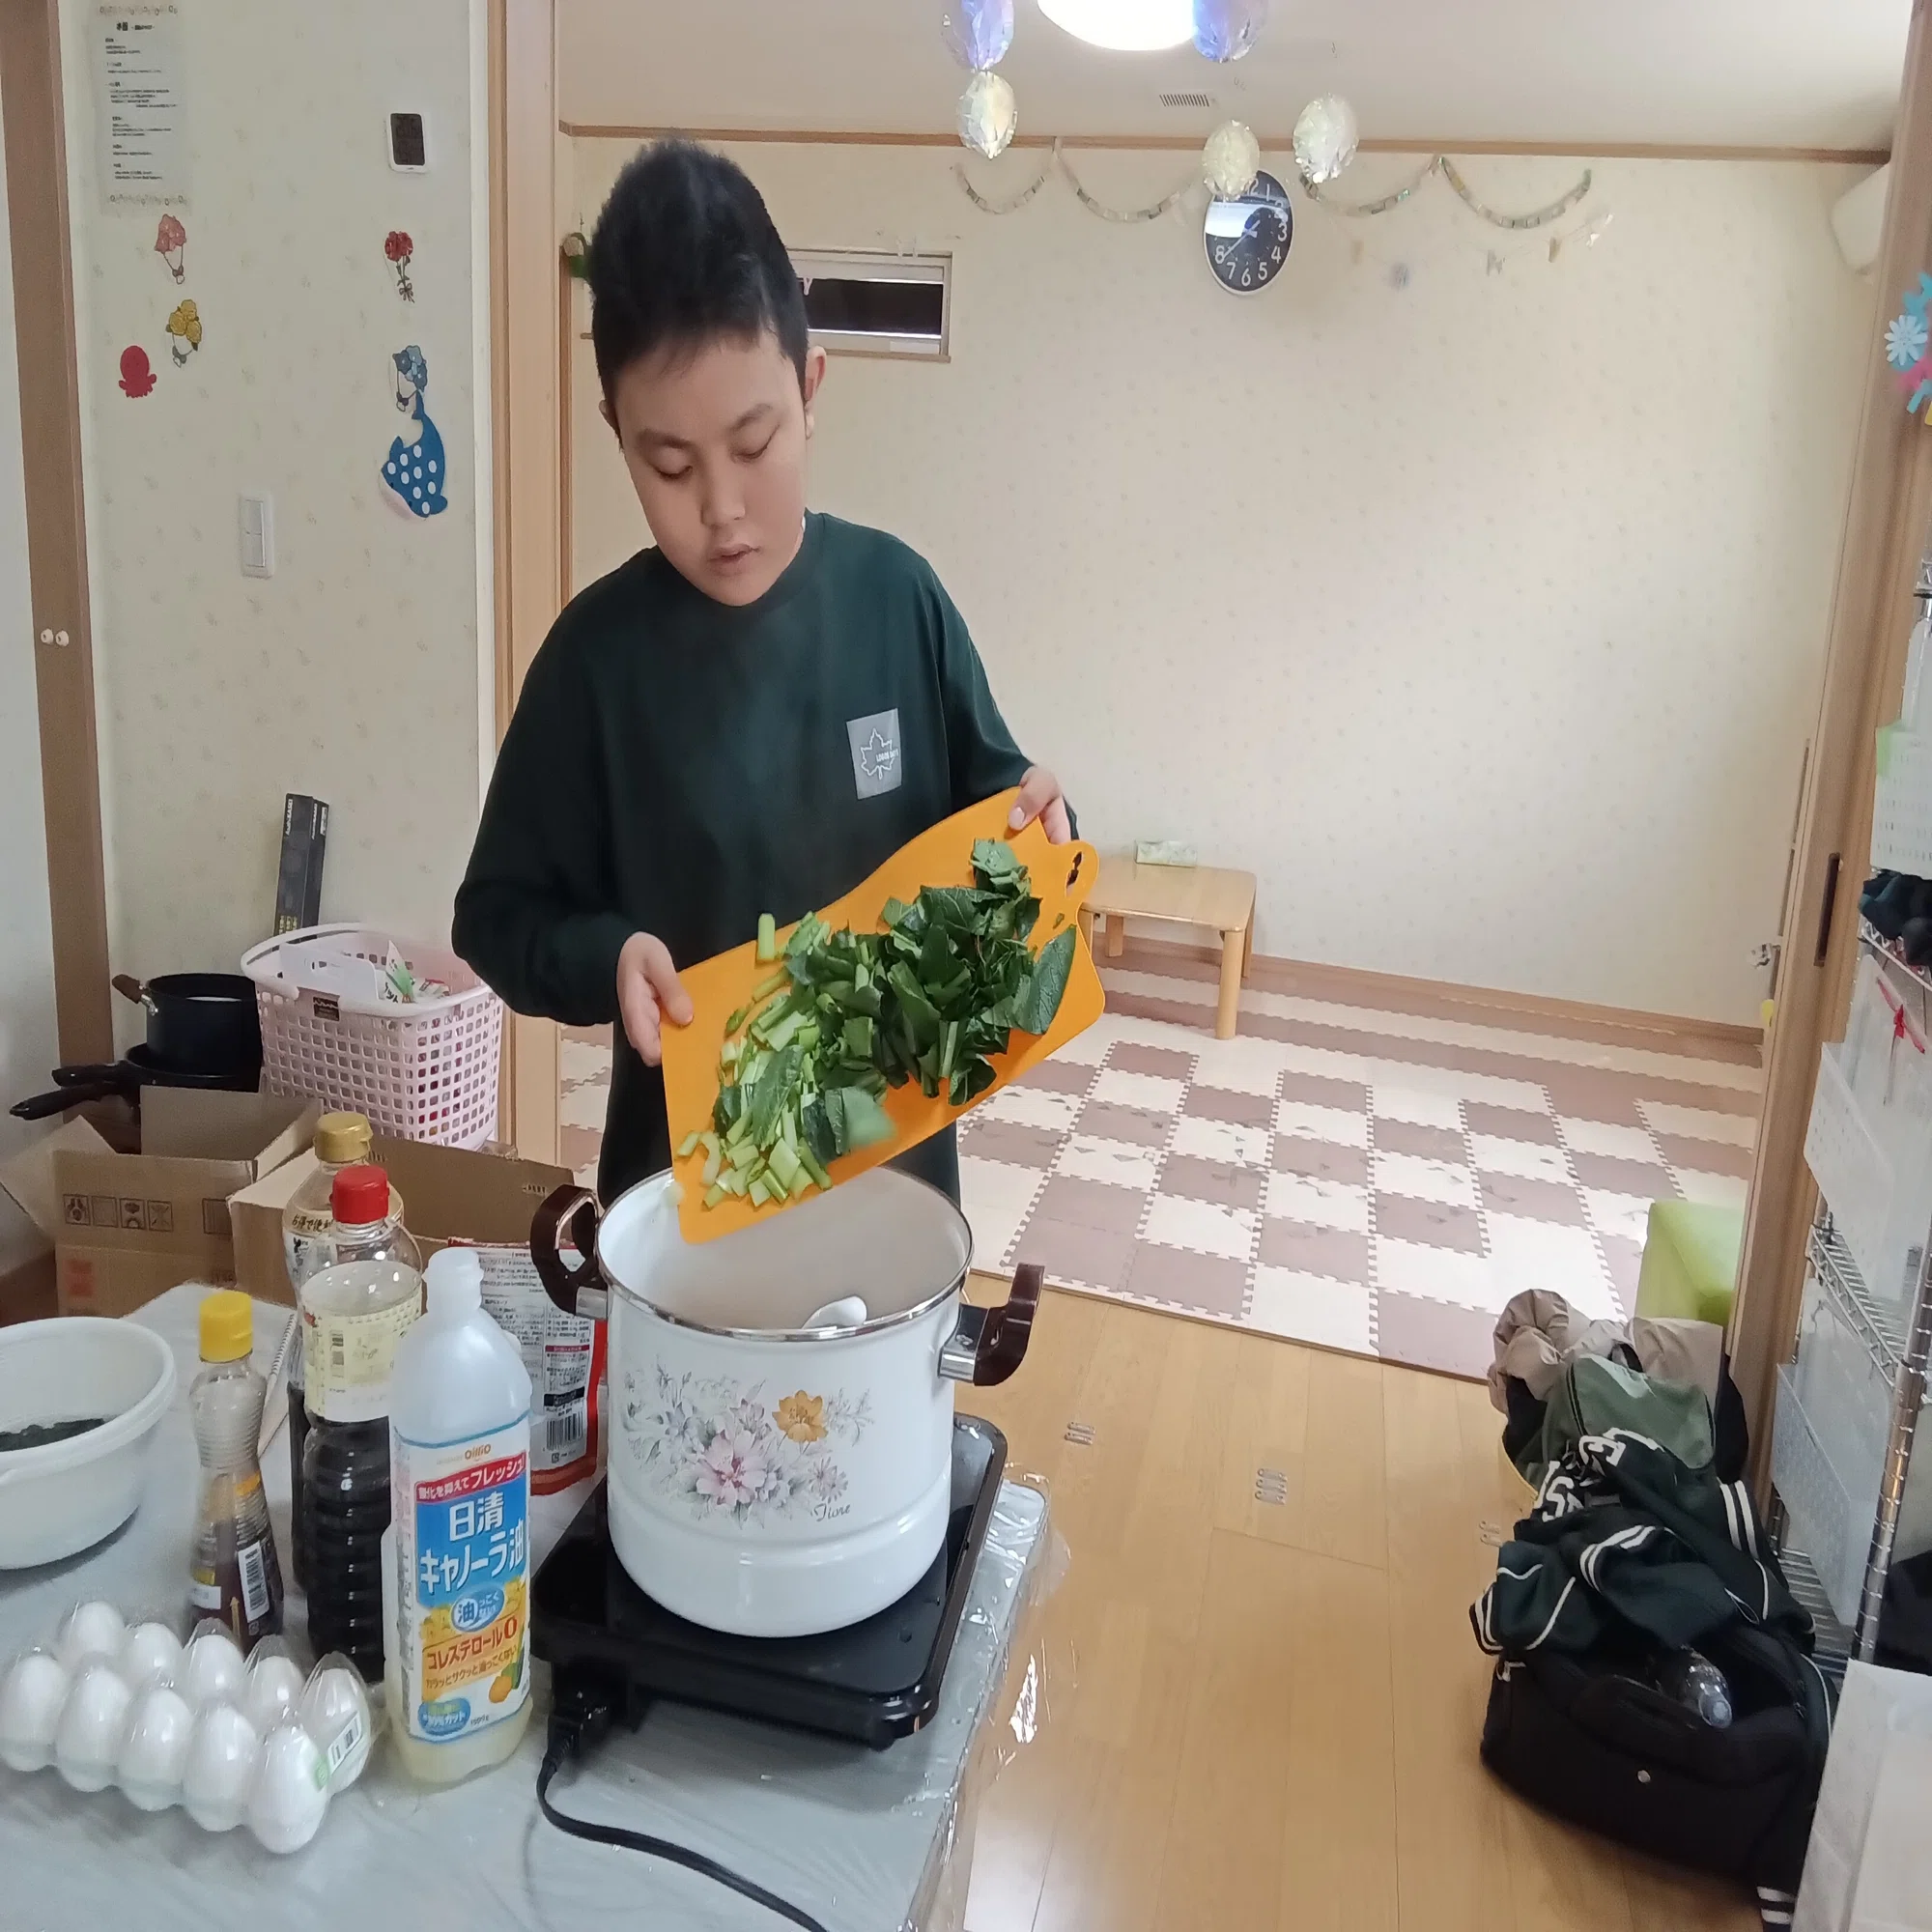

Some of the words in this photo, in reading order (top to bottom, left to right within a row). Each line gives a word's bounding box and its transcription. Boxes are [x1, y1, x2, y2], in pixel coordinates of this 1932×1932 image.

[1277, 222, 1288, 242] 3
[1214, 244, 1226, 265] 8
[1270, 244, 1282, 264] 4
[1226, 261, 1236, 280] 7
[1240, 267, 1252, 287] 6
[1257, 261, 1268, 281] 5
[449, 1490, 505, 1543] 日清
[420, 1518, 526, 1595] キャノーラ油
